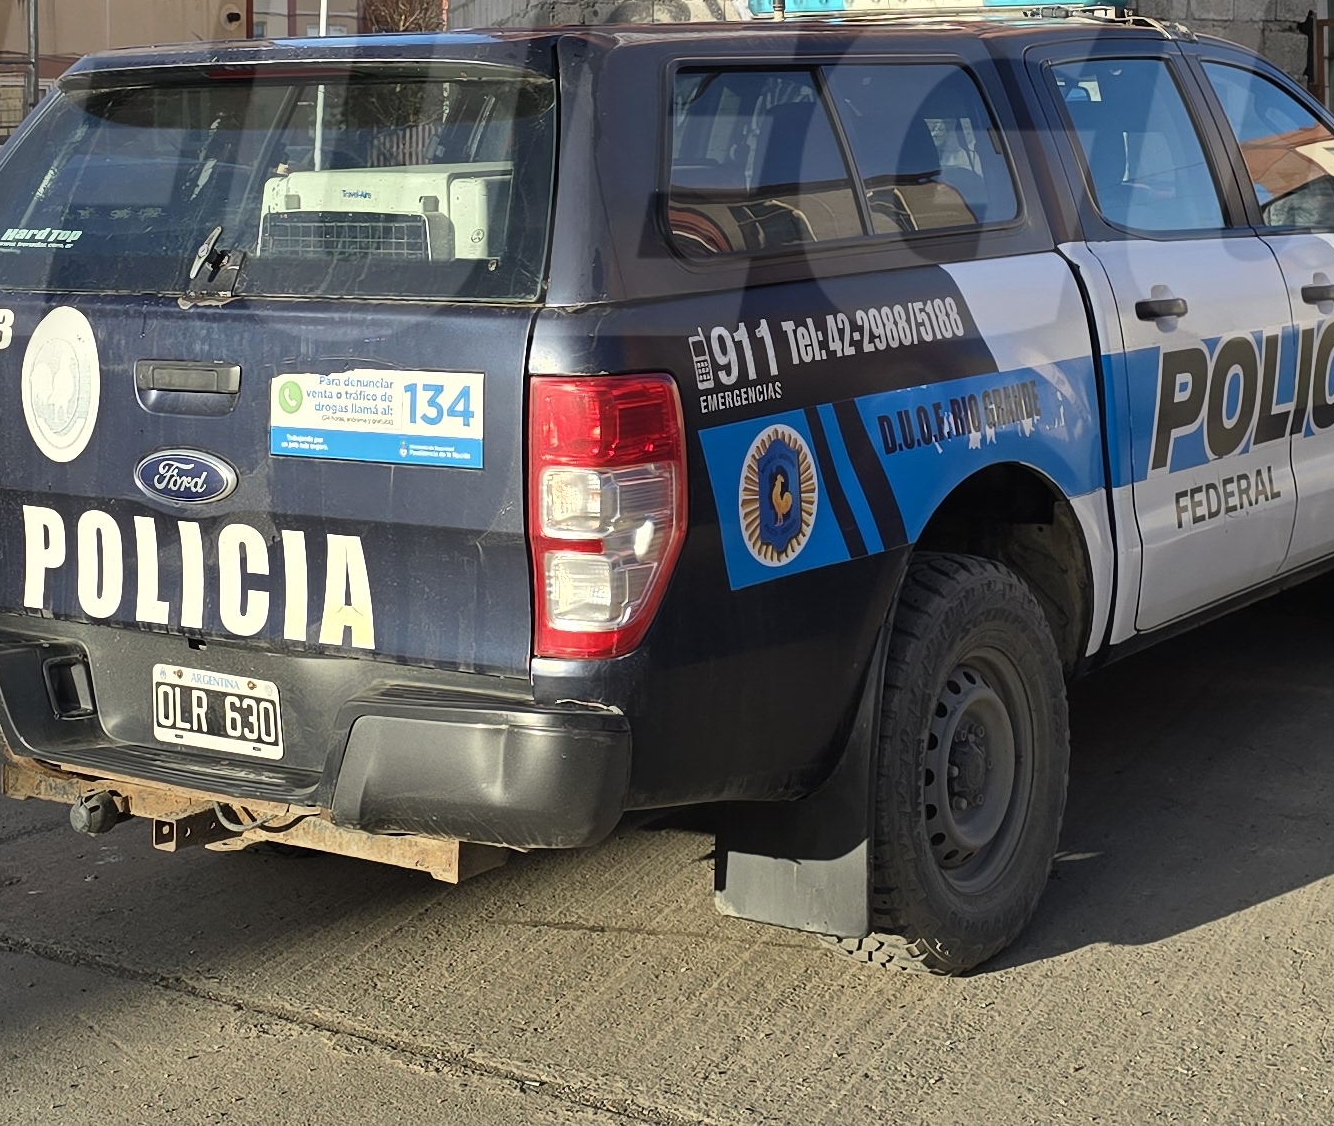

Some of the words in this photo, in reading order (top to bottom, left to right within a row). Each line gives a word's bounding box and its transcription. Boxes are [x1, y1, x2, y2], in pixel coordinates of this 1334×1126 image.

[710, 319, 779, 385] 911
[781, 317, 827, 365] Tel:
[826, 296, 964, 358] 42-2988/5188
[306, 389, 333, 399] venta
[336, 391, 342, 399] o
[345, 389, 378, 401] tráfico
[380, 391, 393, 403] de
[319, 376, 341, 386] Para
[344, 377, 394, 389] denunciar
[699, 381, 783, 414] EMERGENCIAS
[315, 402, 349, 415] drogas
[351, 403, 378, 415] llamá
[380, 405, 393, 416] al:
[403, 382, 475, 427] 134
[153, 460, 208, 493] Ford
[1174, 465, 1282, 530] FEDERAL
[22, 504, 376, 650] POLICIA
[190, 672, 241, 690] ARGENTINA
[157, 684, 208, 733] OLR
[224, 695, 276, 743] 630
